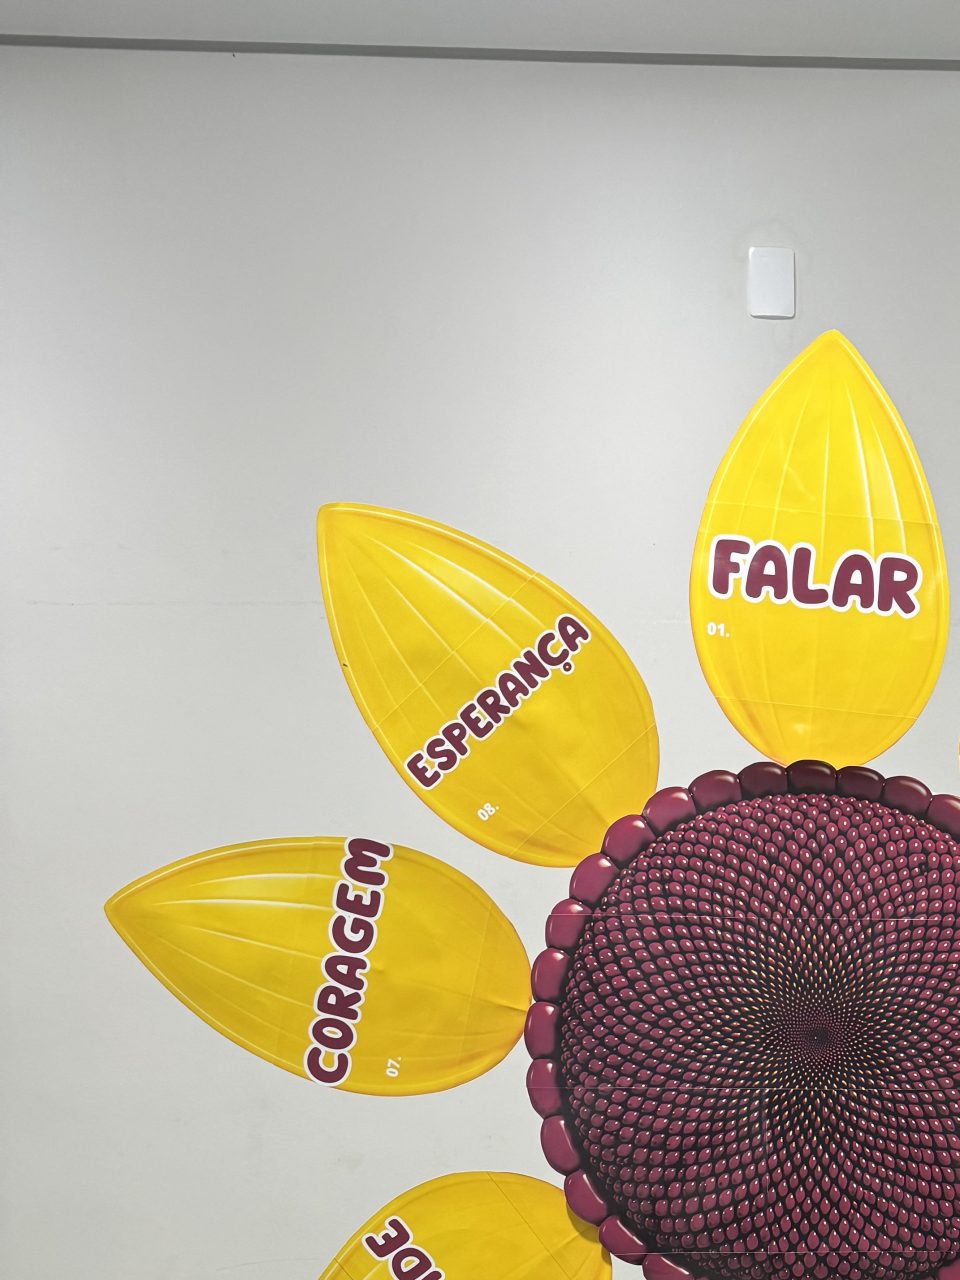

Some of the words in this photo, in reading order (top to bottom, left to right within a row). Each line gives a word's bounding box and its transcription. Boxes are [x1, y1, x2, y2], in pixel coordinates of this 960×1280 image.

[710, 539, 920, 616] FALAR
[707, 622, 731, 638] 01.
[405, 614, 590, 790] ESPERANÇA
[477, 802, 499, 822] 08.
[306, 836, 393, 1086] CORAGEM
[386, 1056, 402, 1077] 07.
